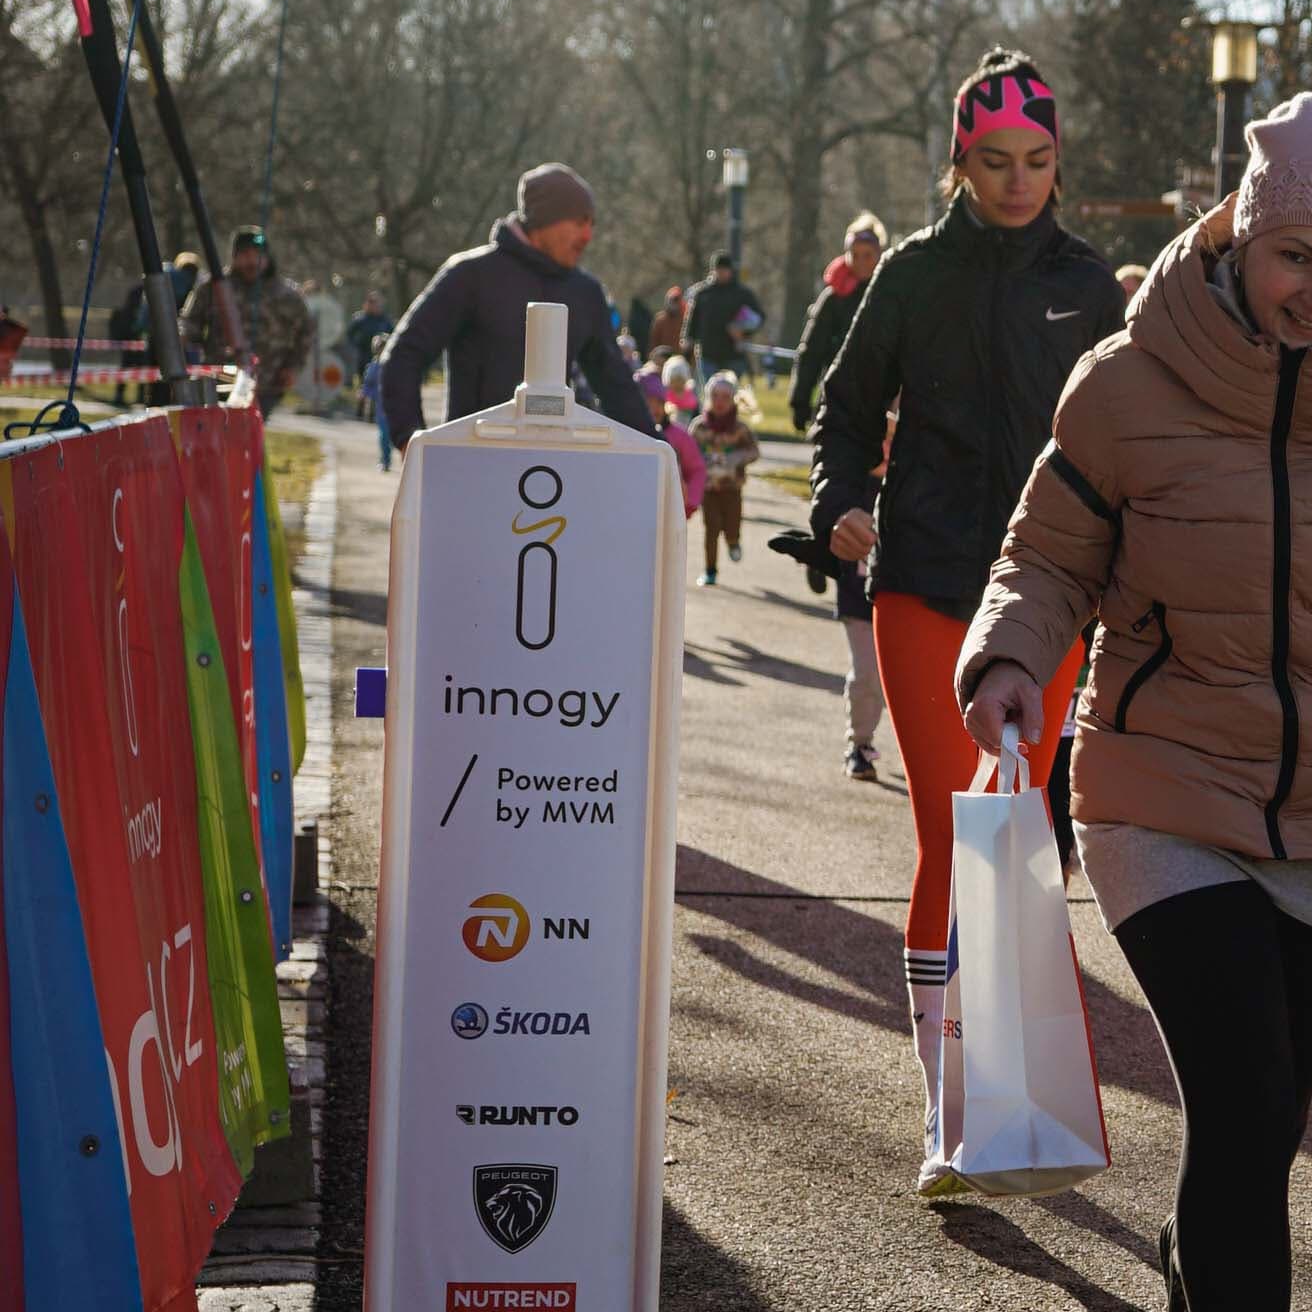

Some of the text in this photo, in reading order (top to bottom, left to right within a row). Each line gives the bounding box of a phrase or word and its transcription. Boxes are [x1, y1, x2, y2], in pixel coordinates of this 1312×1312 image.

[443, 674, 621, 728] innogy
[497, 768, 618, 793] Powered
[496, 799, 615, 829] by MVM
[544, 917, 590, 941] NN
[492, 1007, 591, 1035] ŠKODA
[479, 1106, 580, 1126] RUNTO
[481, 1170, 550, 1182] PEUGEOT
[453, 1290, 571, 1309] NUTREND
